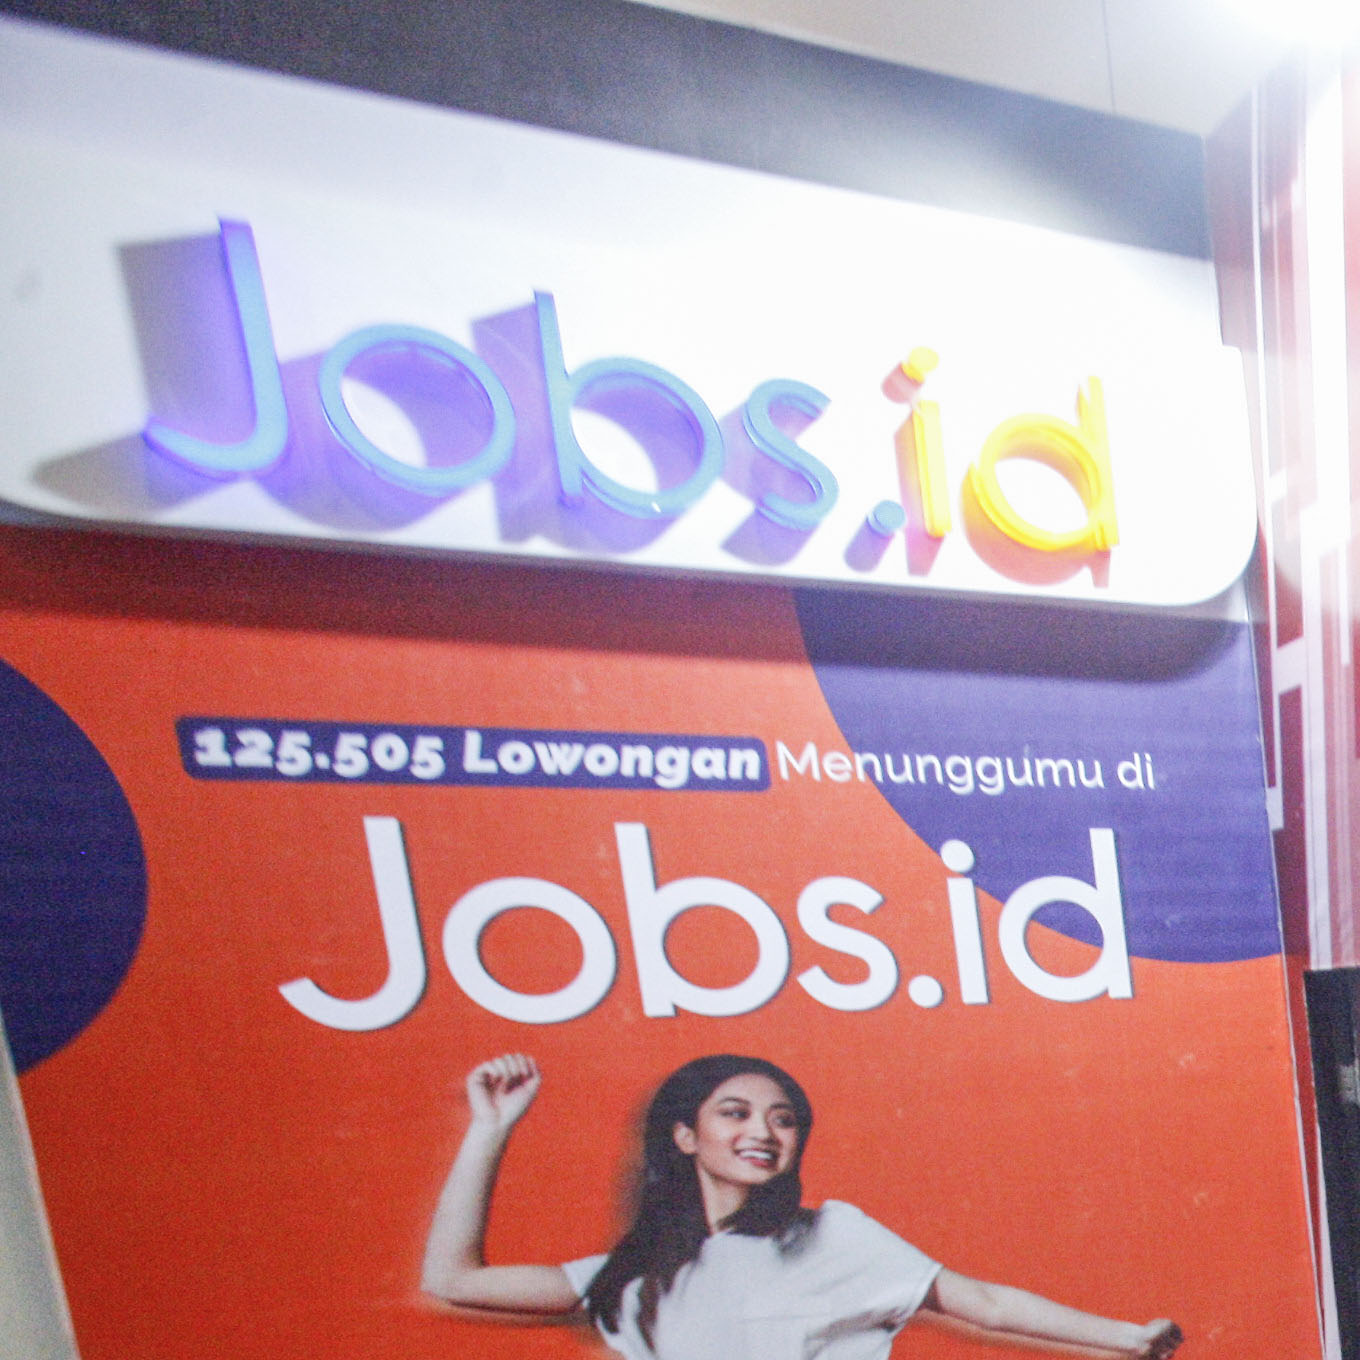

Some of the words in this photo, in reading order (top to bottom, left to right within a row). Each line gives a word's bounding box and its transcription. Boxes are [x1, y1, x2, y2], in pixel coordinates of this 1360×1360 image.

[142, 216, 1119, 552] Jobs.id
[194, 726, 446, 779] 125.505
[462, 731, 763, 787] Lowongan
[776, 740, 1106, 796] Menunggumu
[1116, 750, 1157, 791] di
[278, 815, 1134, 1032] Jobs.id
